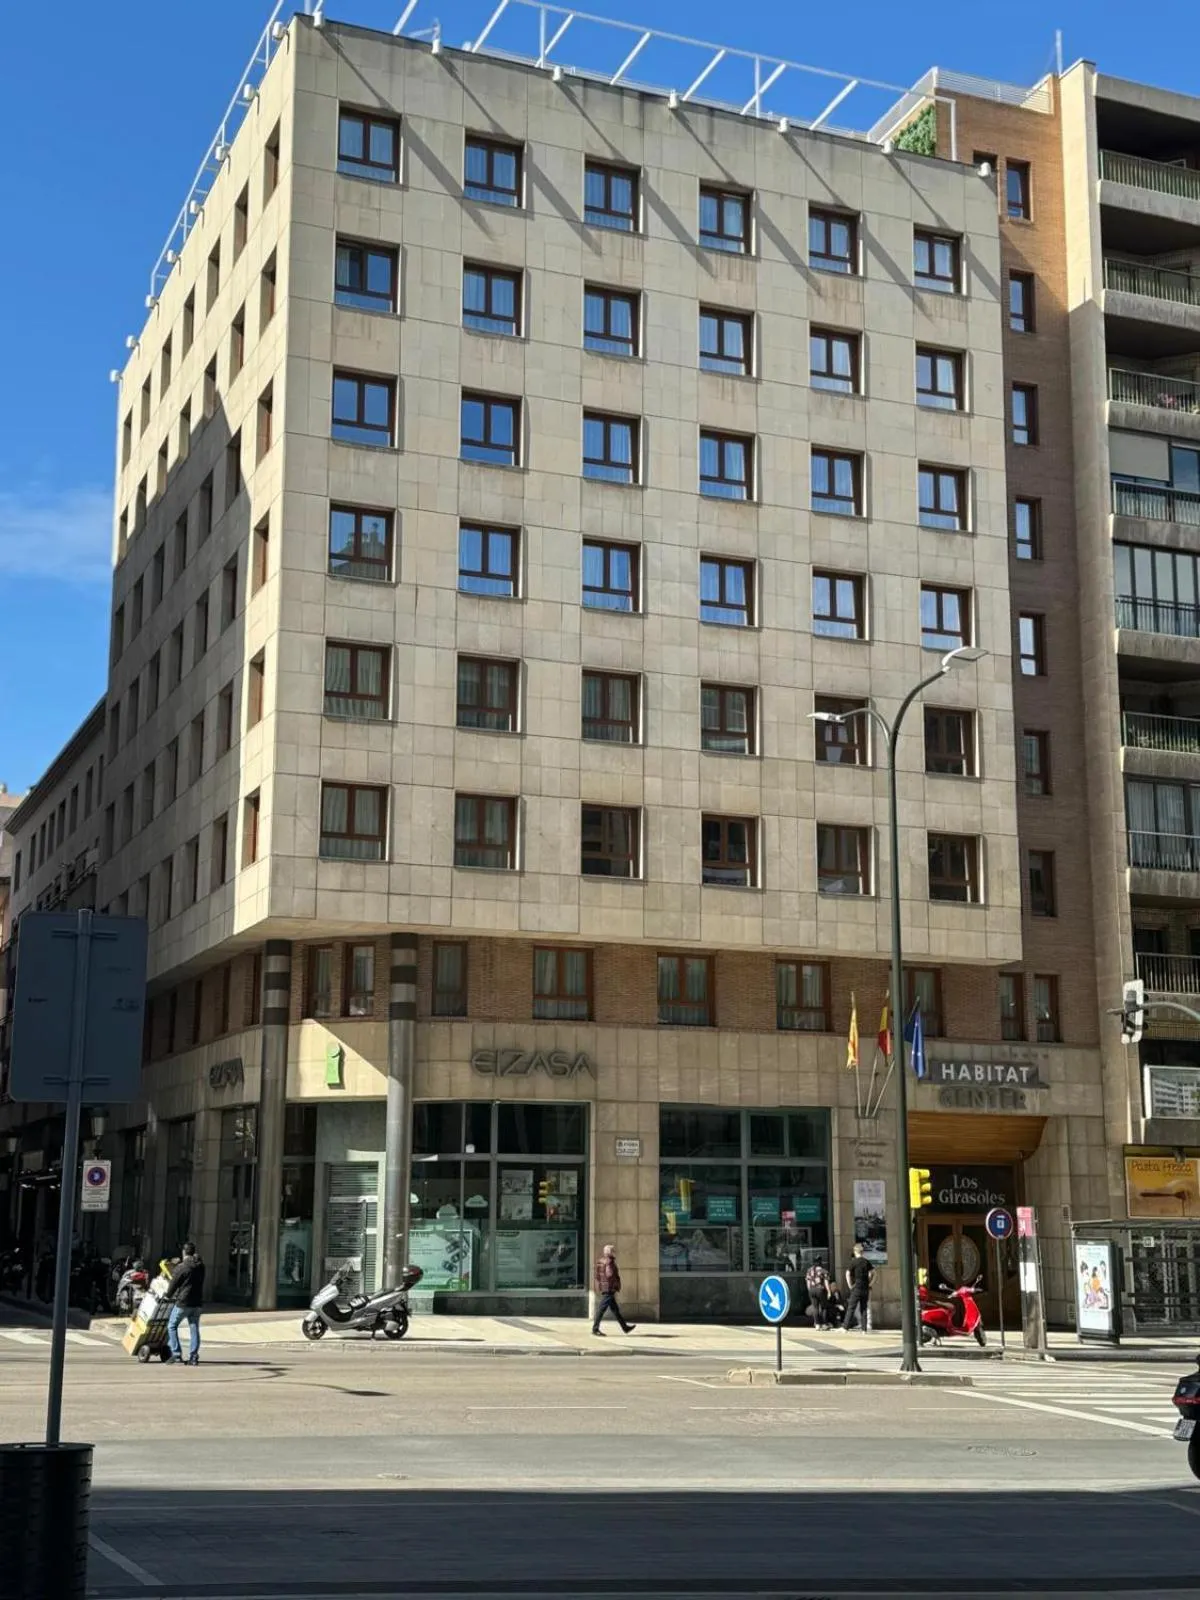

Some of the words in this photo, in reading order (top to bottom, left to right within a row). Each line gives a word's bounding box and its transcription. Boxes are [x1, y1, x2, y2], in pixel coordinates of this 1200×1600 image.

[941, 1063, 1030, 1083] HABITAT
[953, 1174, 978, 1189] Los
[939, 1189, 1006, 1205] Girasoles
